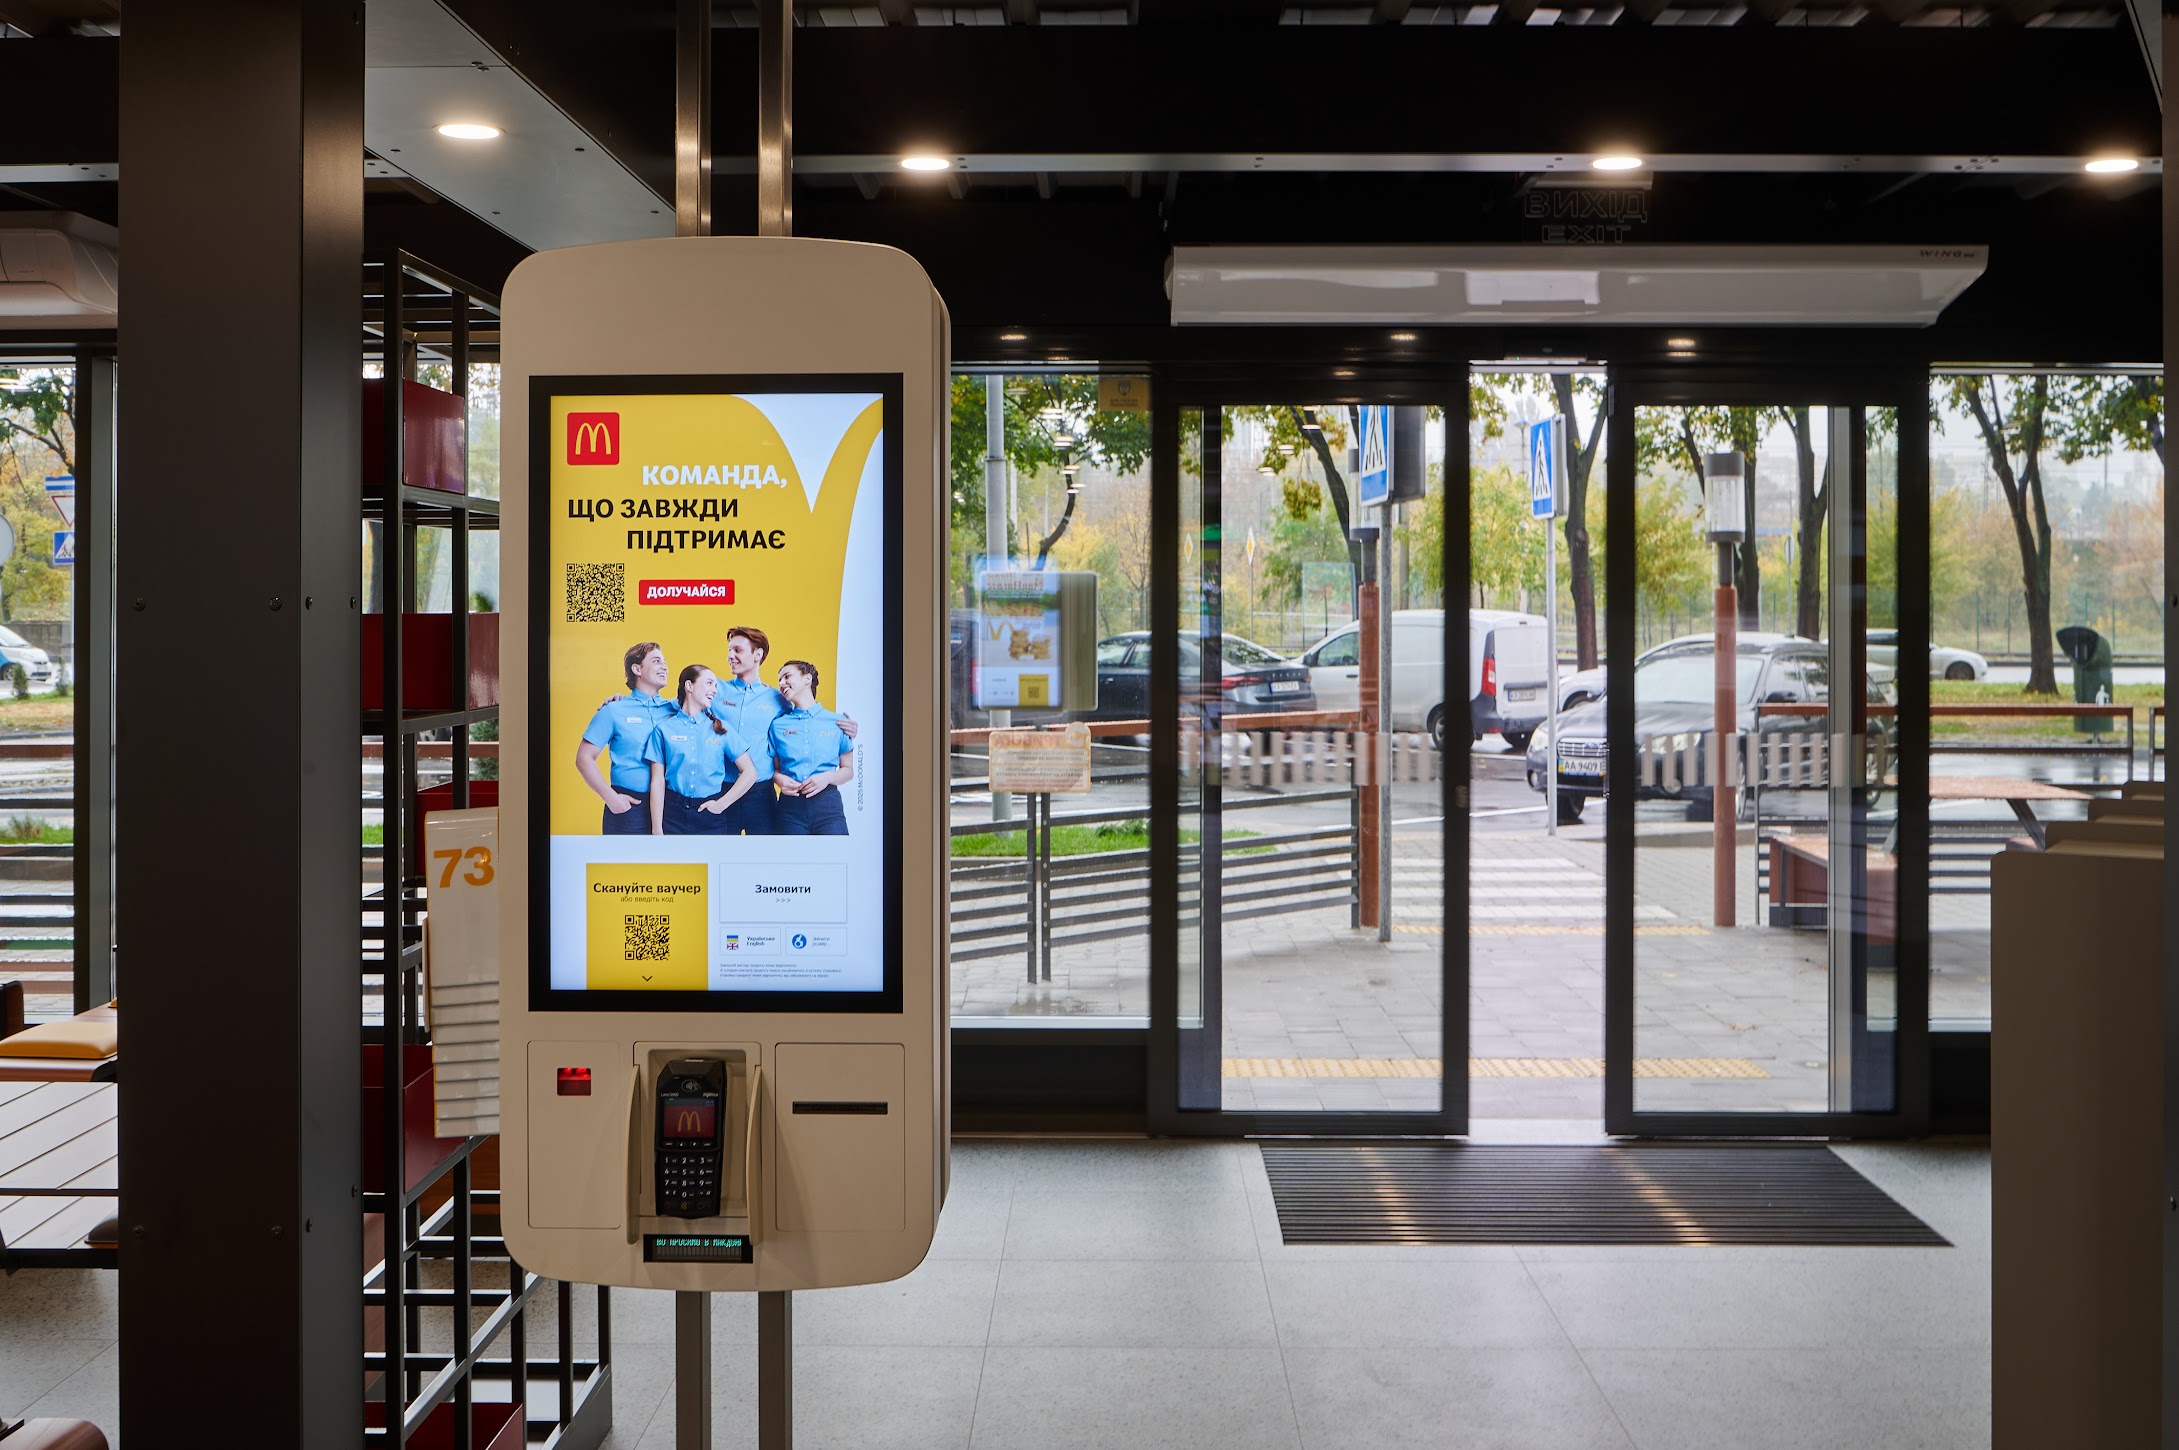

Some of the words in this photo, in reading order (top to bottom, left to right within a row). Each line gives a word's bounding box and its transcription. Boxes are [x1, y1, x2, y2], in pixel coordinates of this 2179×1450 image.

[1524, 190, 1648, 223] ВИХІД
[1542, 224, 1631, 244] EXIT
[642, 464, 787, 489] КОМАНДА,
[568, 498, 614, 522] ЩО
[620, 498, 739, 522] ЗАВЖДИ
[627, 529, 786, 553] ПІДТРИМАЄ
[646, 583, 726, 600] ДОЛУЧАЙСЯ
[433, 846, 495, 888] 73
[593, 882, 653, 895] Скануйте
[657, 884, 701, 895] ваучер
[620, 895, 633, 903] або
[634, 895, 660, 903] введіть
[755, 884, 811, 894] Замовити
